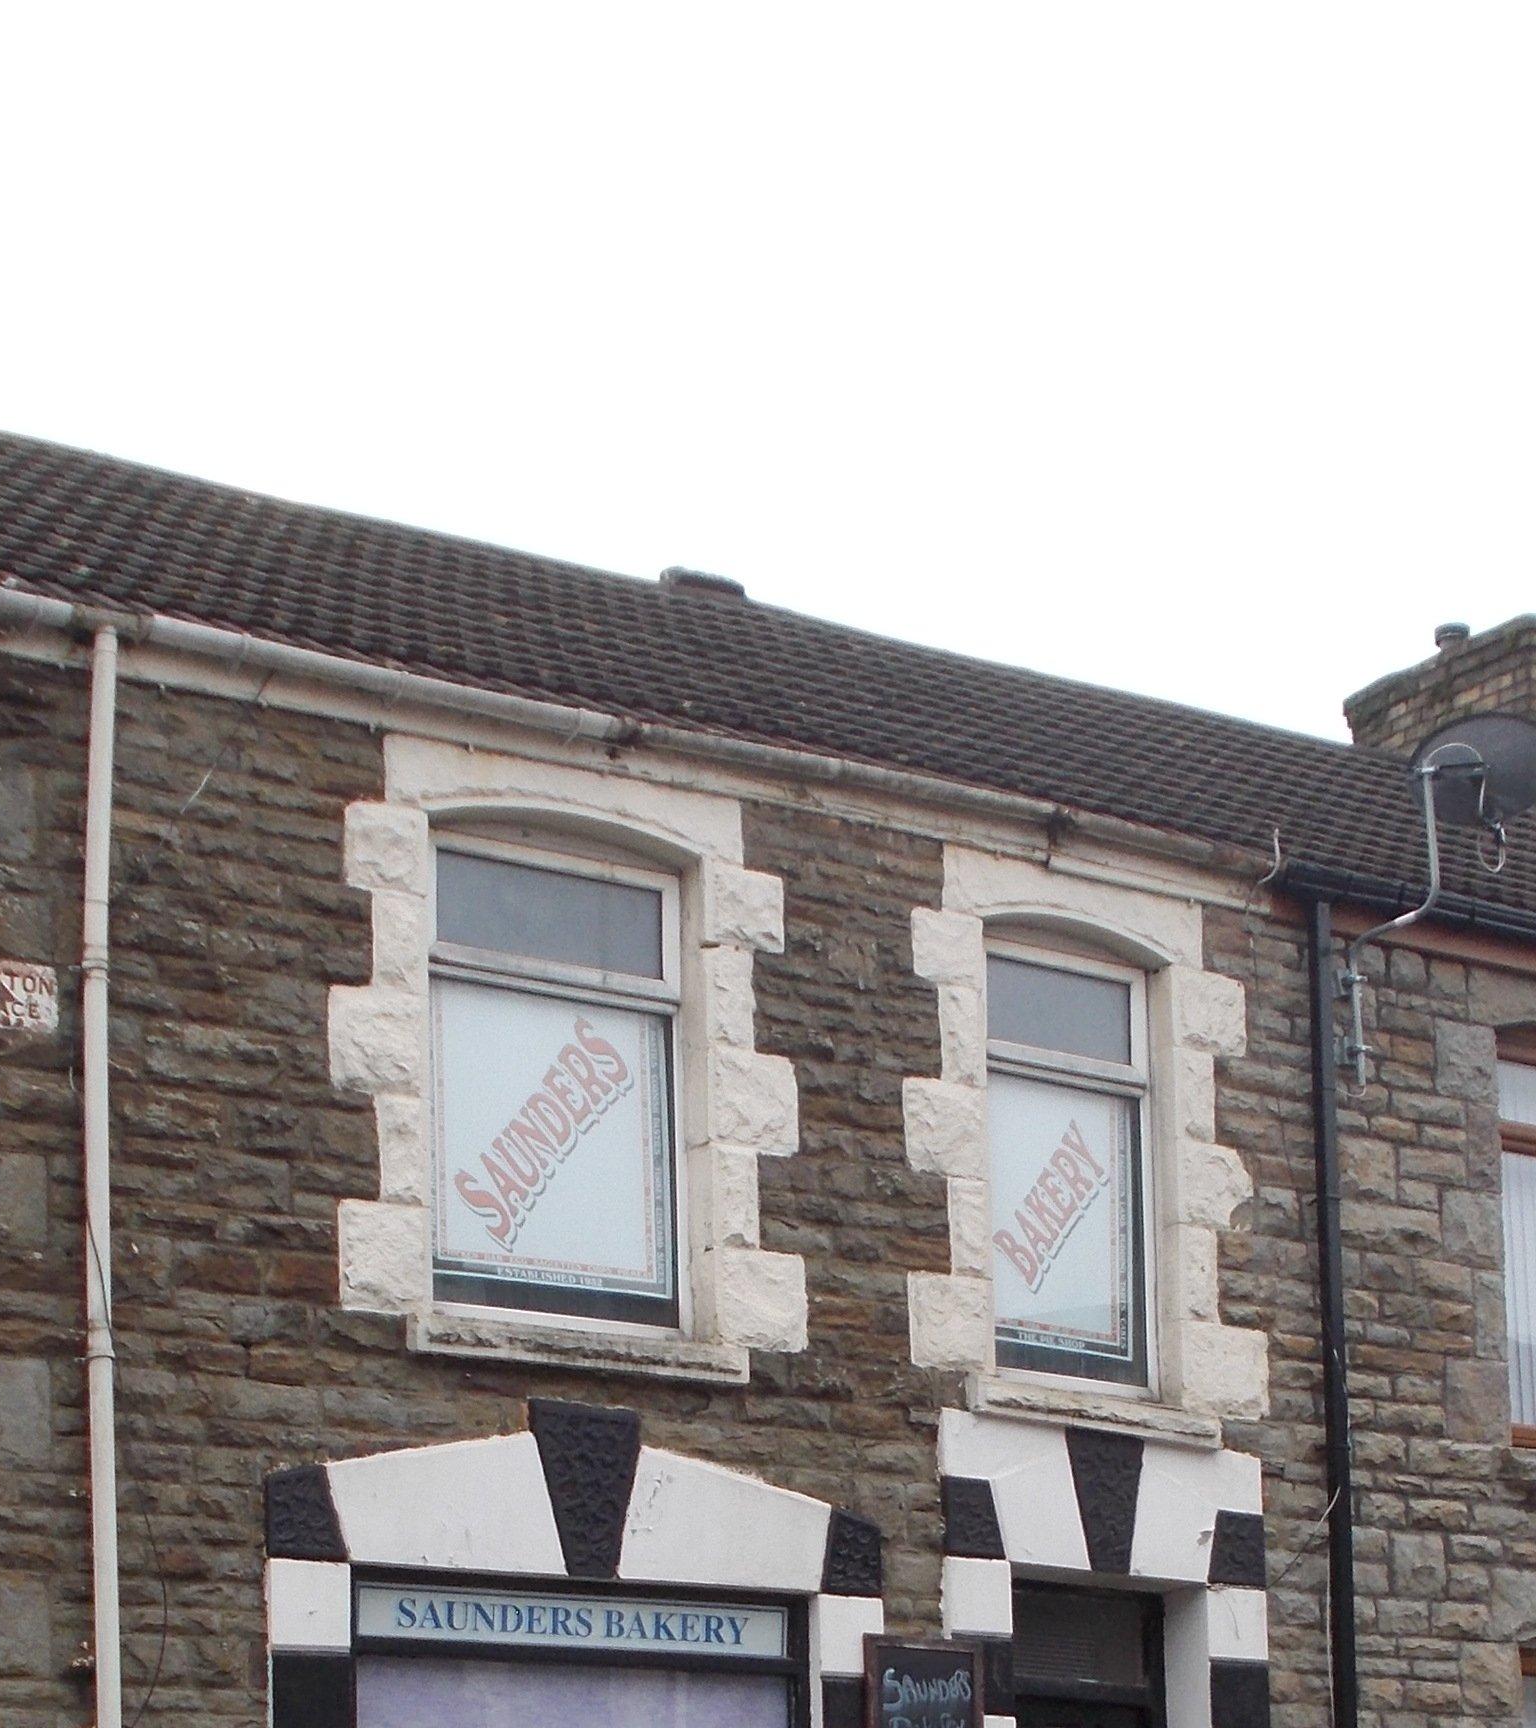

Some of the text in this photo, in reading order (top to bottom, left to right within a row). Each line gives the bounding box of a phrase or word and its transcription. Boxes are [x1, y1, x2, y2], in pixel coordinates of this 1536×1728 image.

[453, 1016, 635, 1253] SAUNDERS
[991, 1118, 1110, 1295] BAKERY
[496, 1266, 576, 1286] ESTABLISHED
[397, 1597, 749, 1645] SAUNDERS BAKERY
